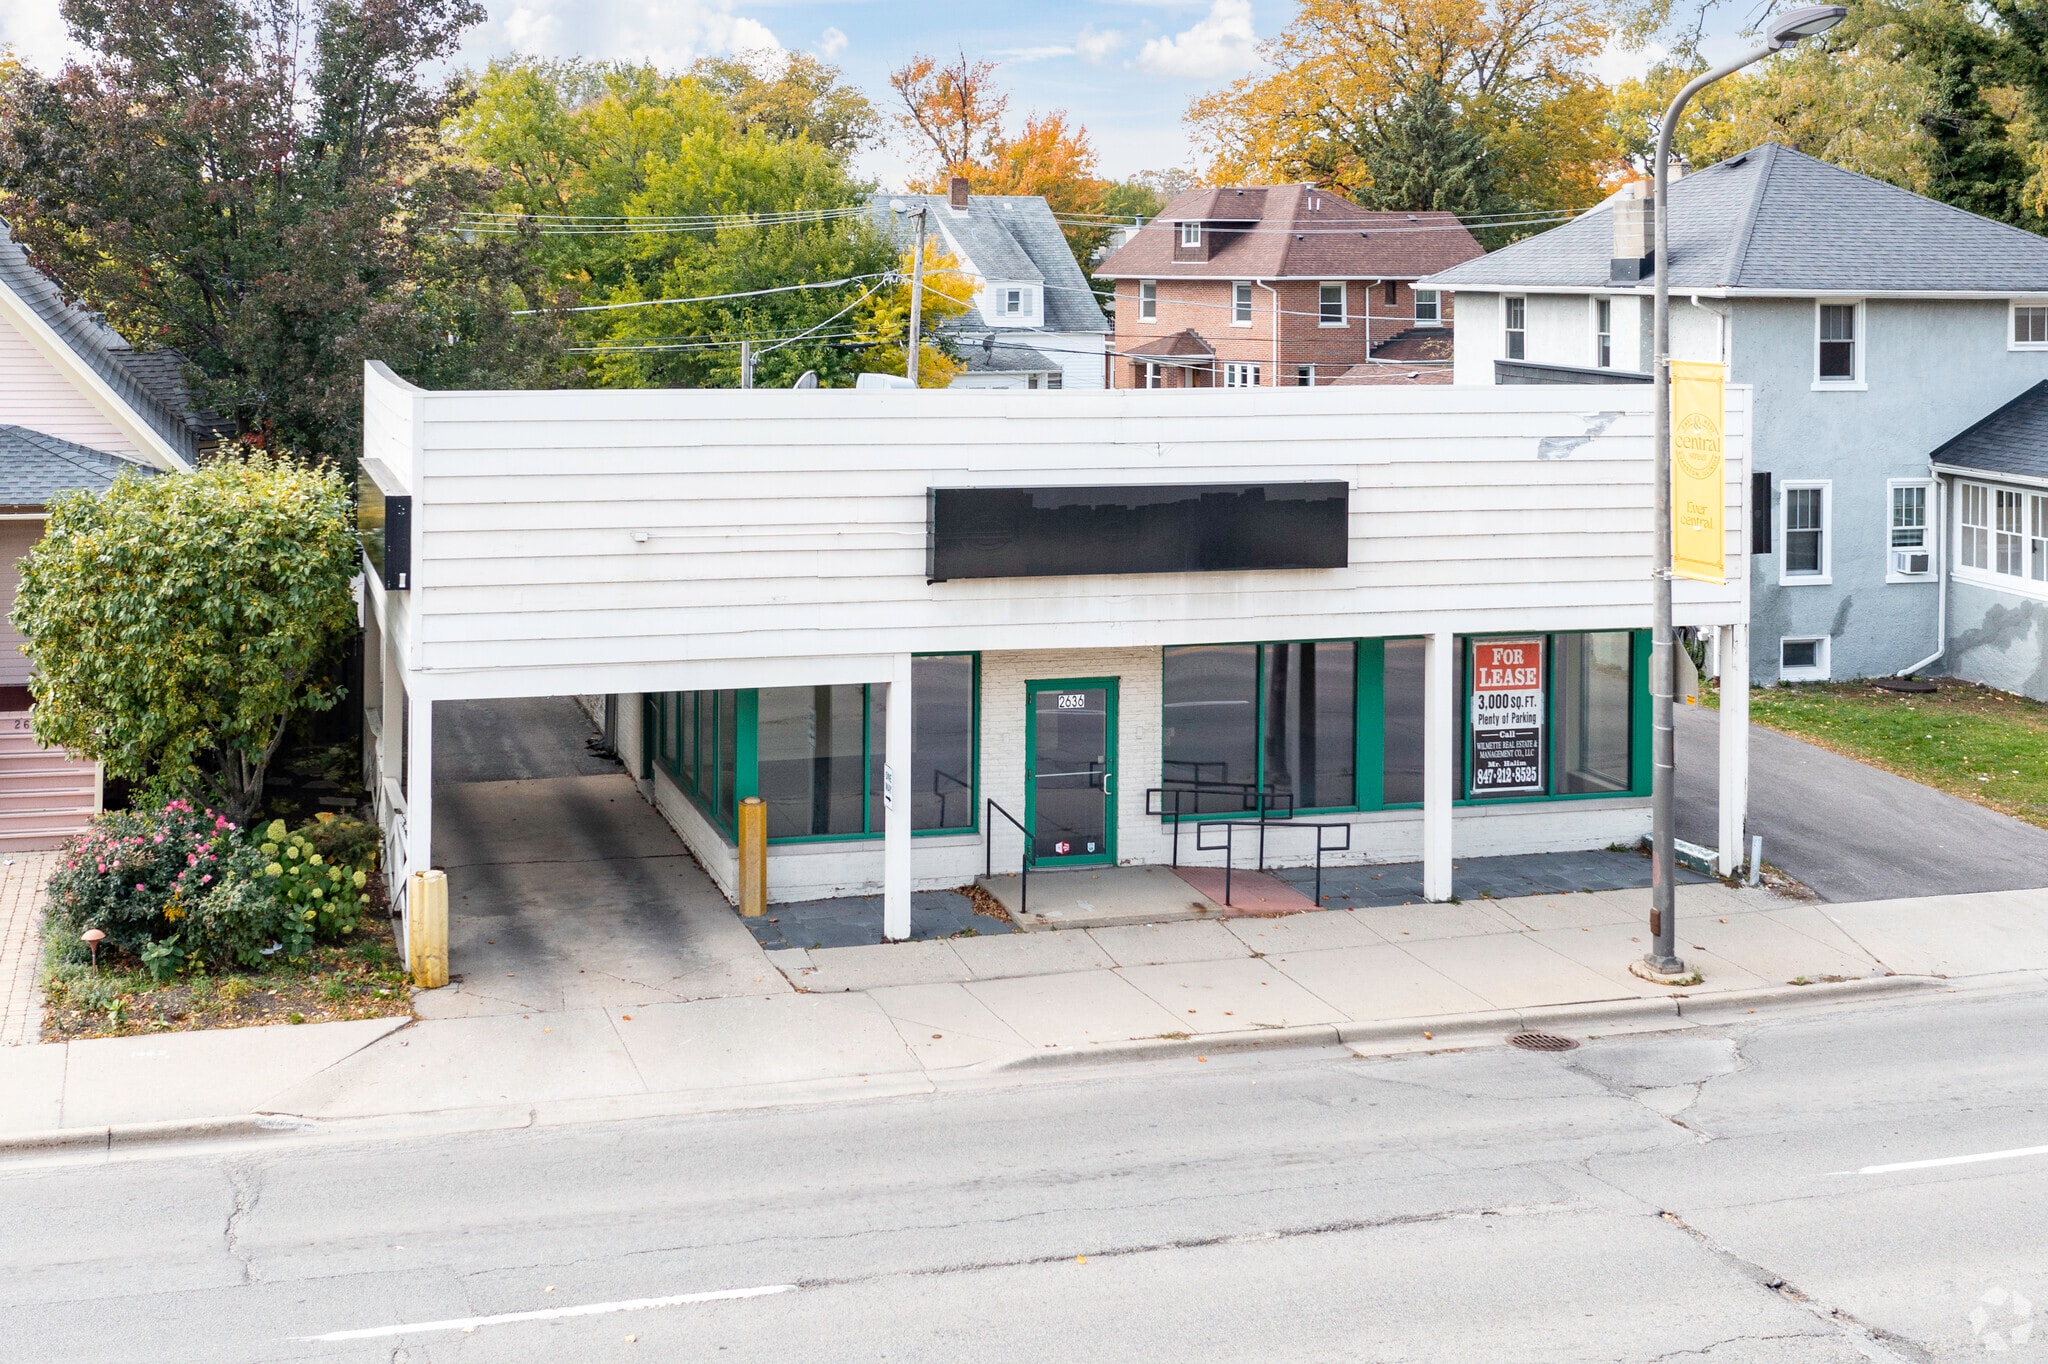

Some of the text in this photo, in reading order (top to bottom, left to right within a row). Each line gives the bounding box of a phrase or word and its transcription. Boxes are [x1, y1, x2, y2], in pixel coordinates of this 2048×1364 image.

[1693, 415, 1702, 430] &
[1675, 435, 1720, 453] central
[1687, 501, 1708, 515] Ever
[1680, 515, 1713, 529] central
[1492, 647, 1524, 665] FOR
[1479, 667, 1537, 687] LEASE
[1059, 695, 1084, 708] 2636
[1478, 693, 1509, 710] 3,000
[1478, 711, 1537, 727] Plenty of Parking
[1499, 730, 1516, 738] Call
[1476, 739, 1538, 750] WILMETTE REAL ESTATE &
[1479, 749, 1515, 759] MANAGEMENT
[1524, 748, 1535, 757] LLC
